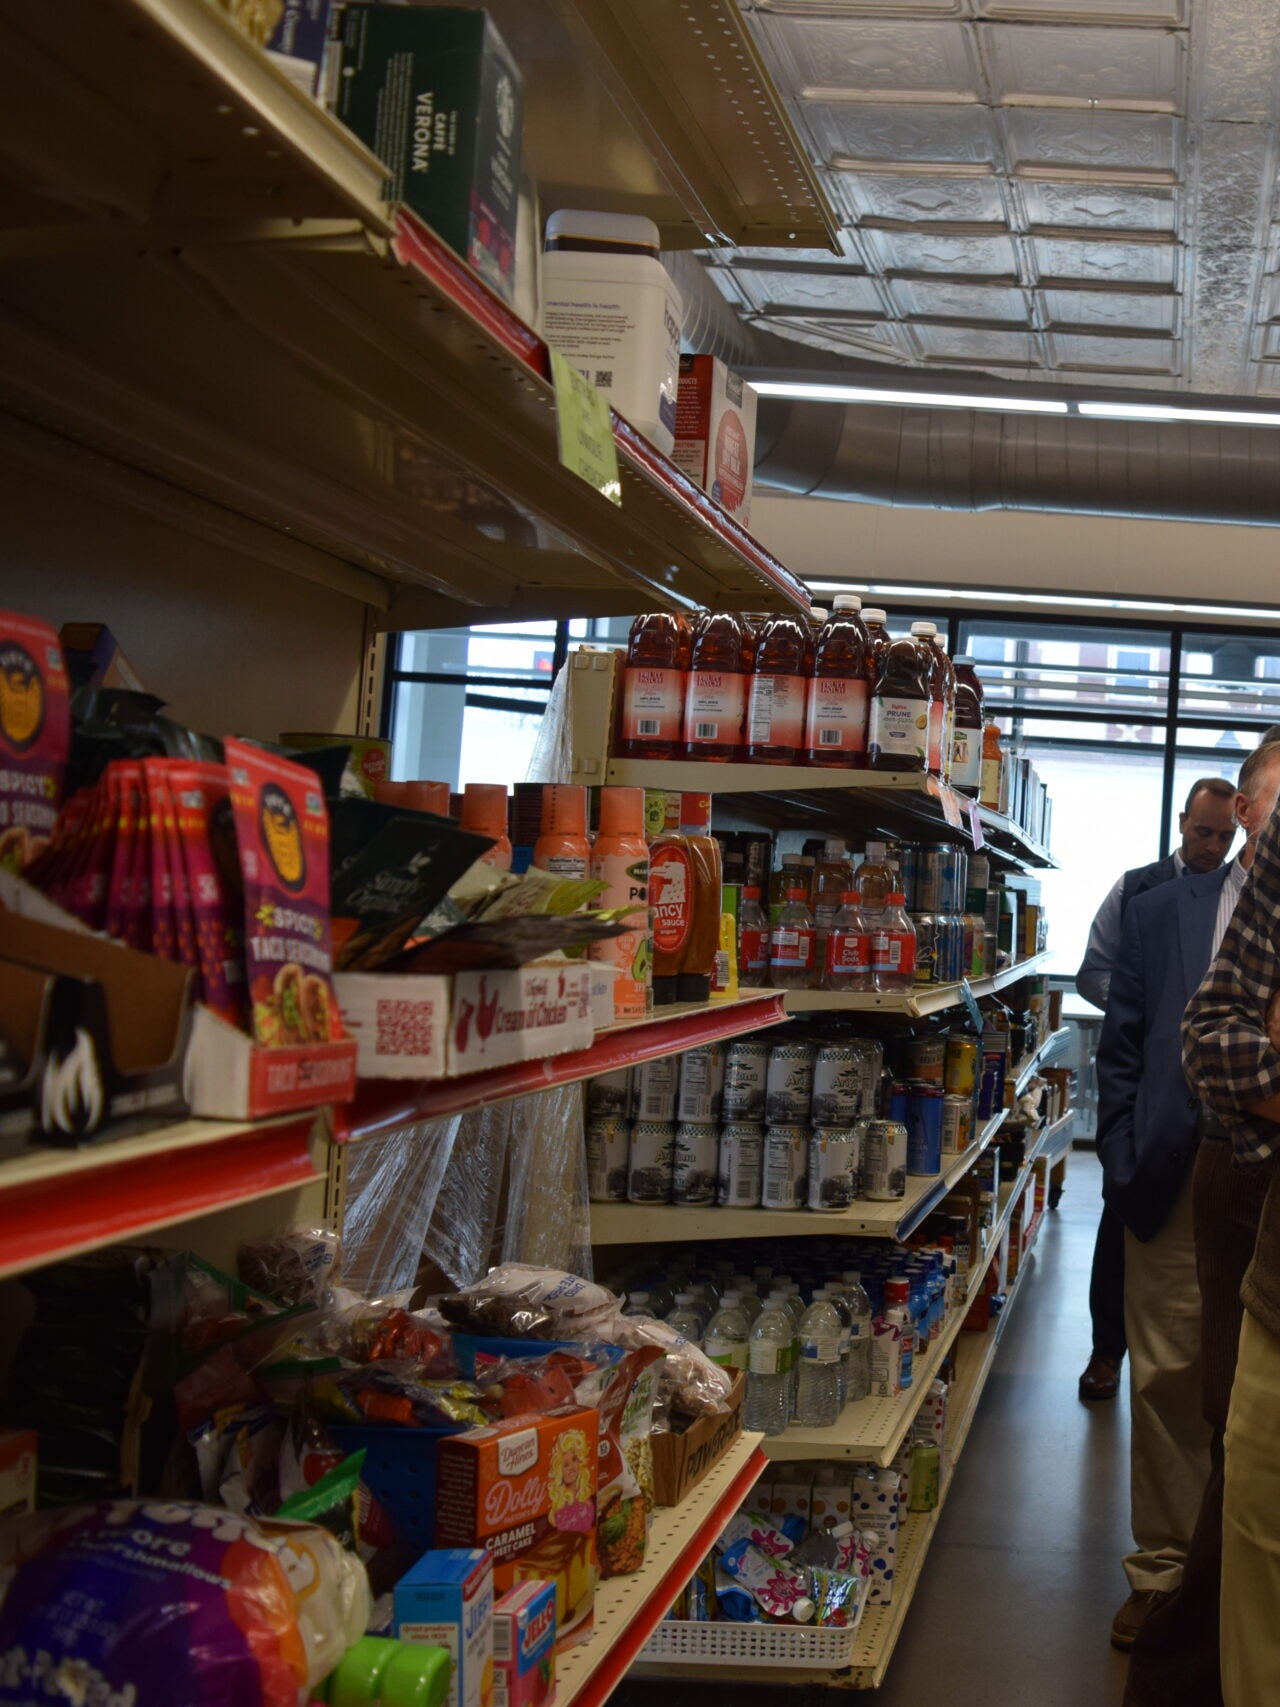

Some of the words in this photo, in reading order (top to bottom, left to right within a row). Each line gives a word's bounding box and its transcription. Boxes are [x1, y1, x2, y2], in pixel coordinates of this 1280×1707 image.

[411, 91, 434, 171] VERONA
[886, 710, 912, 718] PRUNE
[654, 903, 684, 920] ancy
[661, 917, 685, 927] sauce
[250, 936, 286, 962] TACO
[495, 1006, 526, 1034] Cream
[536, 1002, 568, 1027] Chicken
[267, 1064, 297, 1095] TACO
[499, 1438, 536, 1458] Duncan
[506, 1450, 534, 1470] Hines
[484, 1475, 548, 1526] Dolly
[486, 1521, 537, 1550] CARAMEL
[512, 1535, 533, 1551] CAKE
